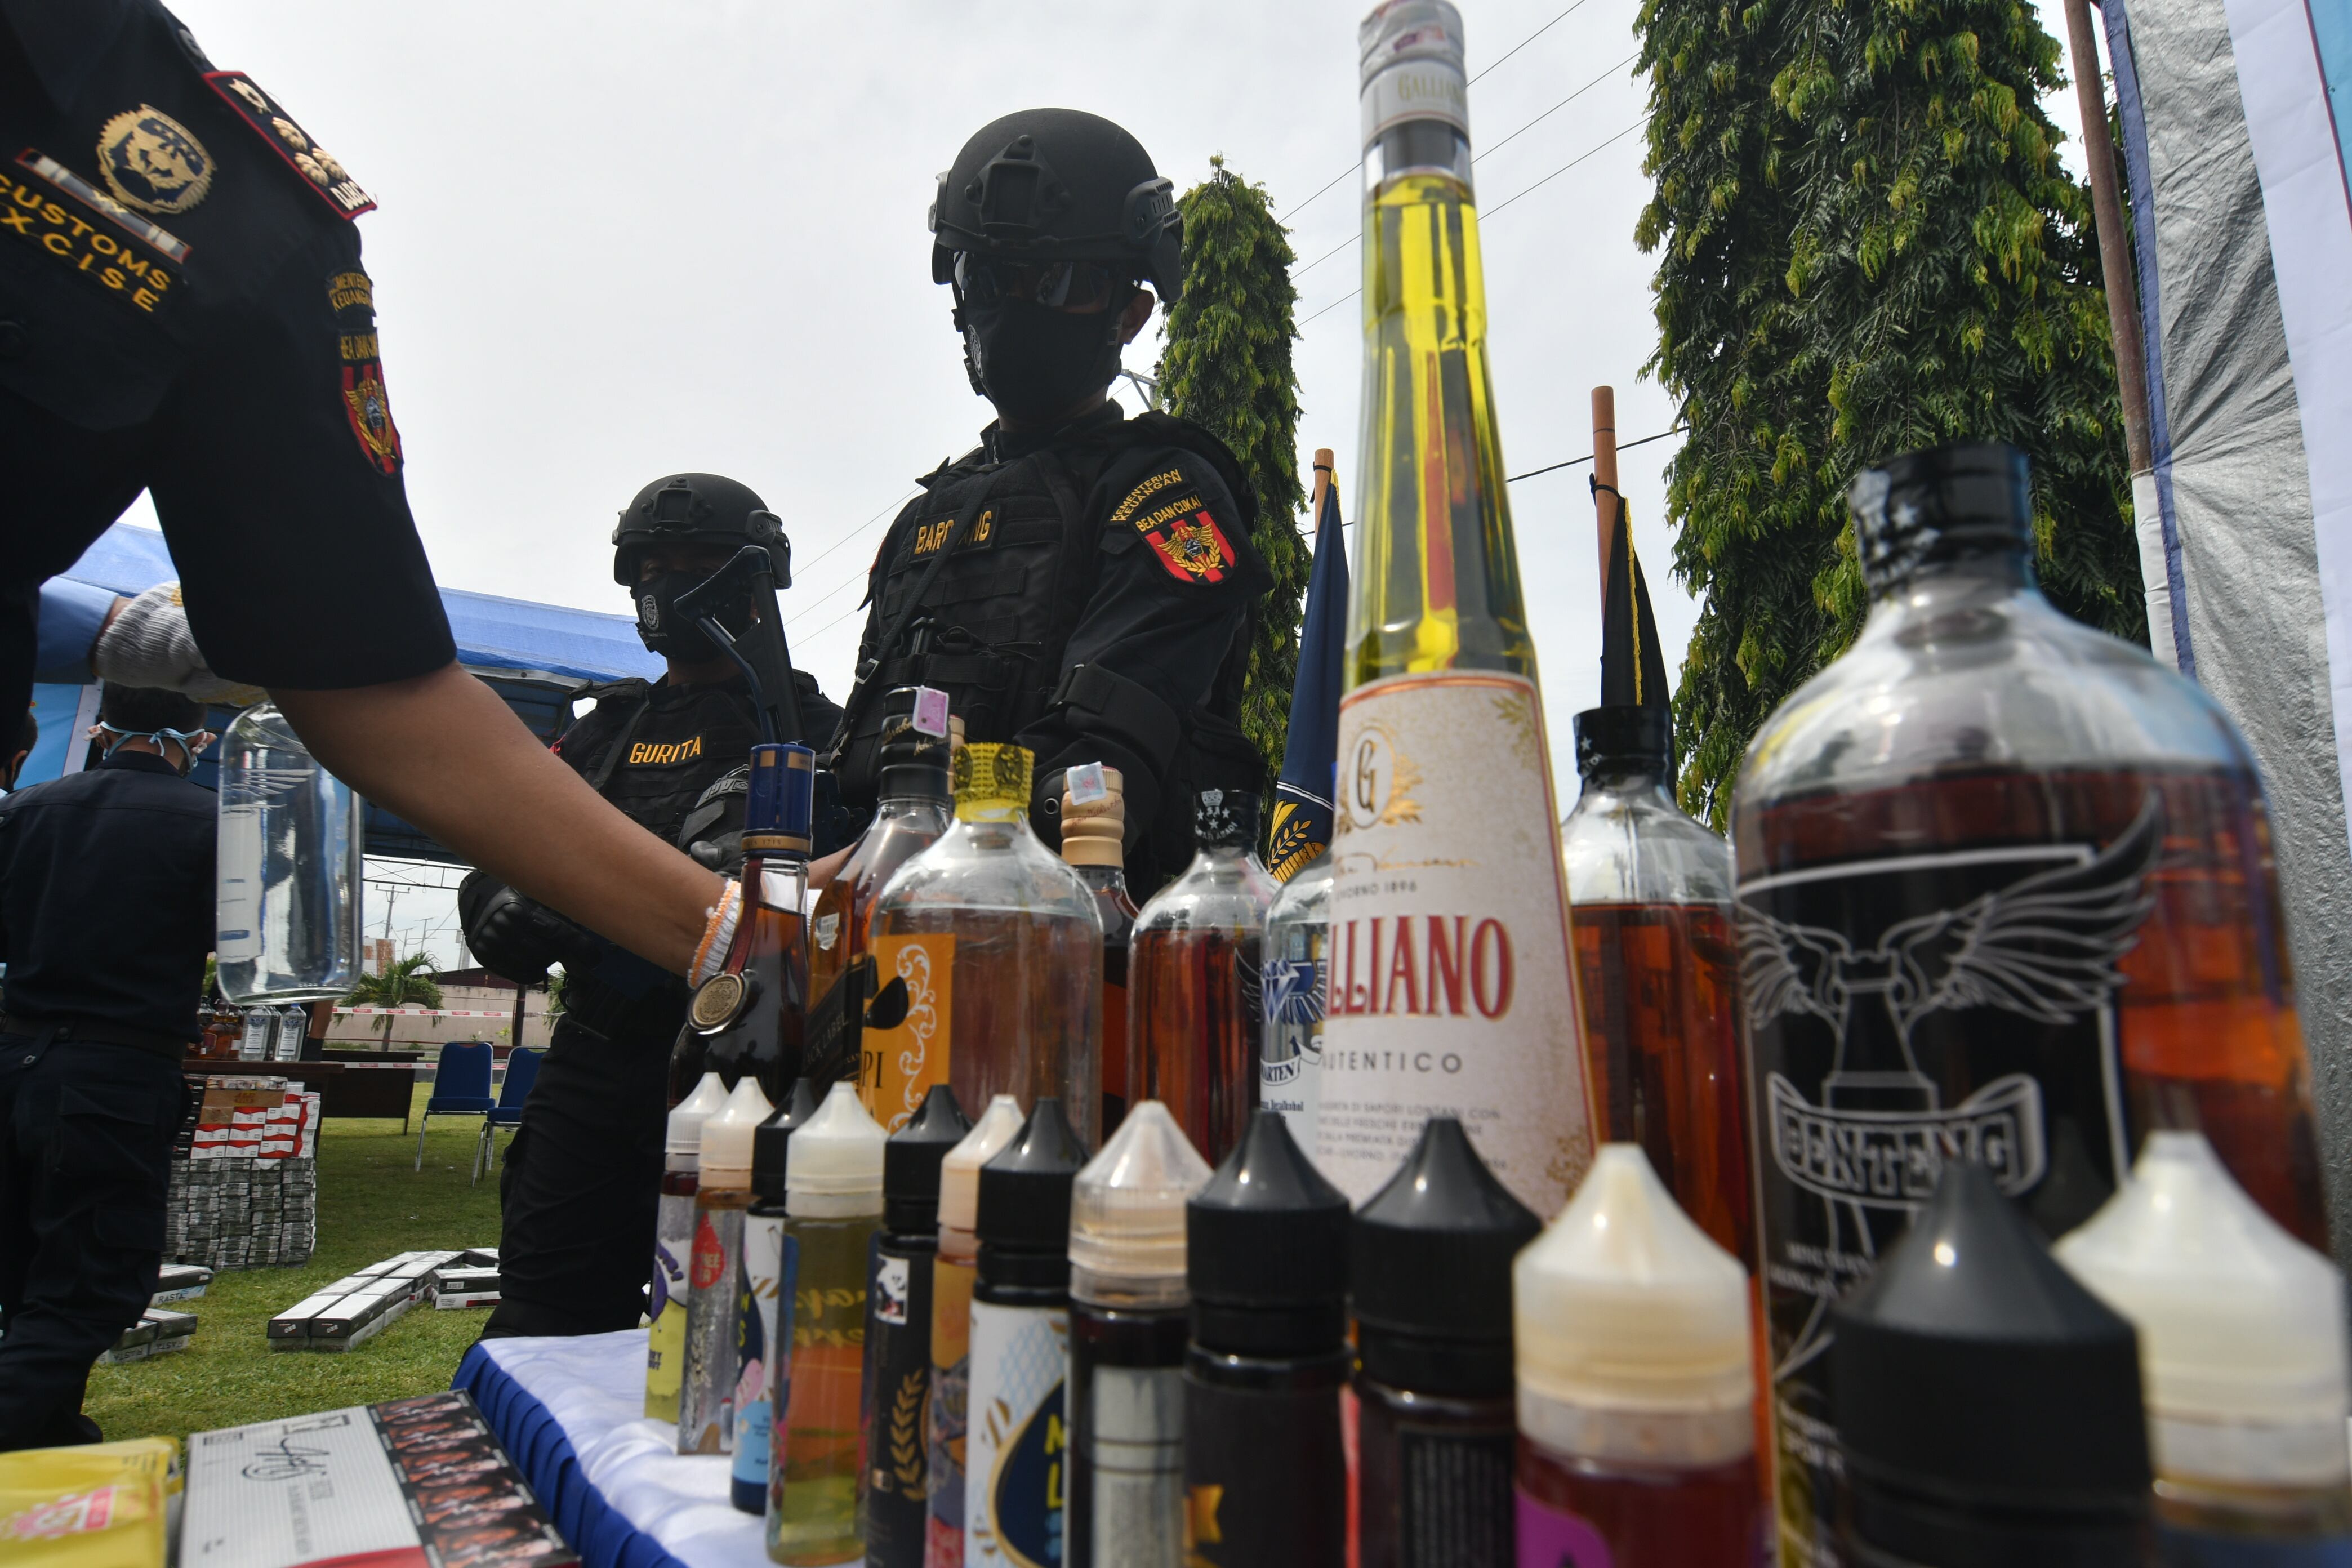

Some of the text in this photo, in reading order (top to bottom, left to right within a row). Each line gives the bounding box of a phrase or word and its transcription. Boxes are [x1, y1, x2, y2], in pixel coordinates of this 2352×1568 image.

[1110, 469, 1179, 521] KEMENTERIAN
[1118, 475, 1182, 520] KEUANGAN
[1135, 495, 1202, 532] BEA DAN CUKAI
[629, 736, 701, 764] GURITA
[1322, 1051, 1463, 1073] UTENTICO
[158, 1293, 185, 1304] RASTA
